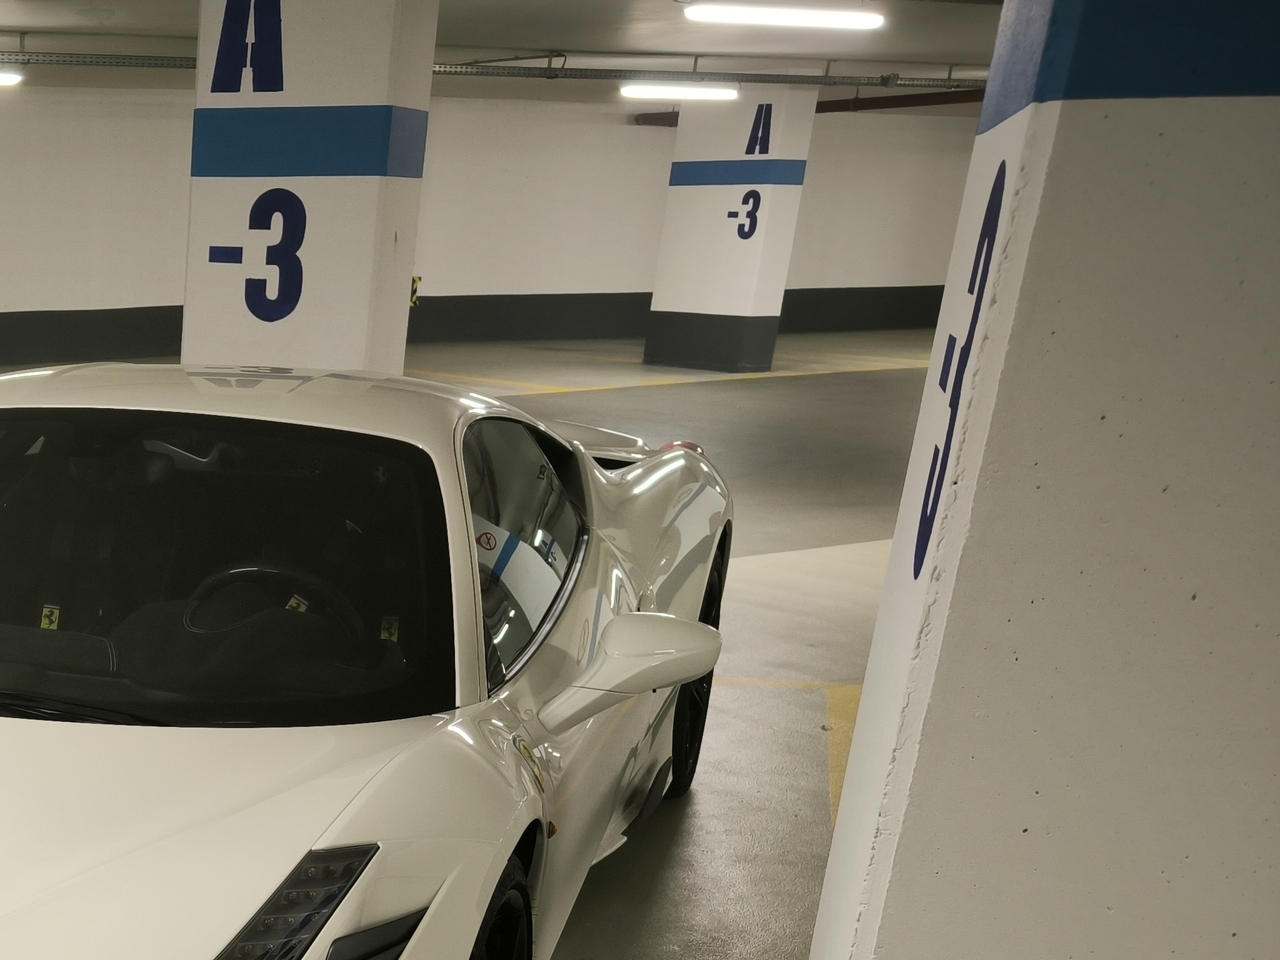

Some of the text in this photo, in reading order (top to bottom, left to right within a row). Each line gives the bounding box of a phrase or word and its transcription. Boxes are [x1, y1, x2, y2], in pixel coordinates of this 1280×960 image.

[211, 0, 284, 93] A
[745, 103, 772, 155] A
[208, 187, 307, 323] -3
[727, 189, 761, 240] -3
[913, 158, 1007, 581] -3
